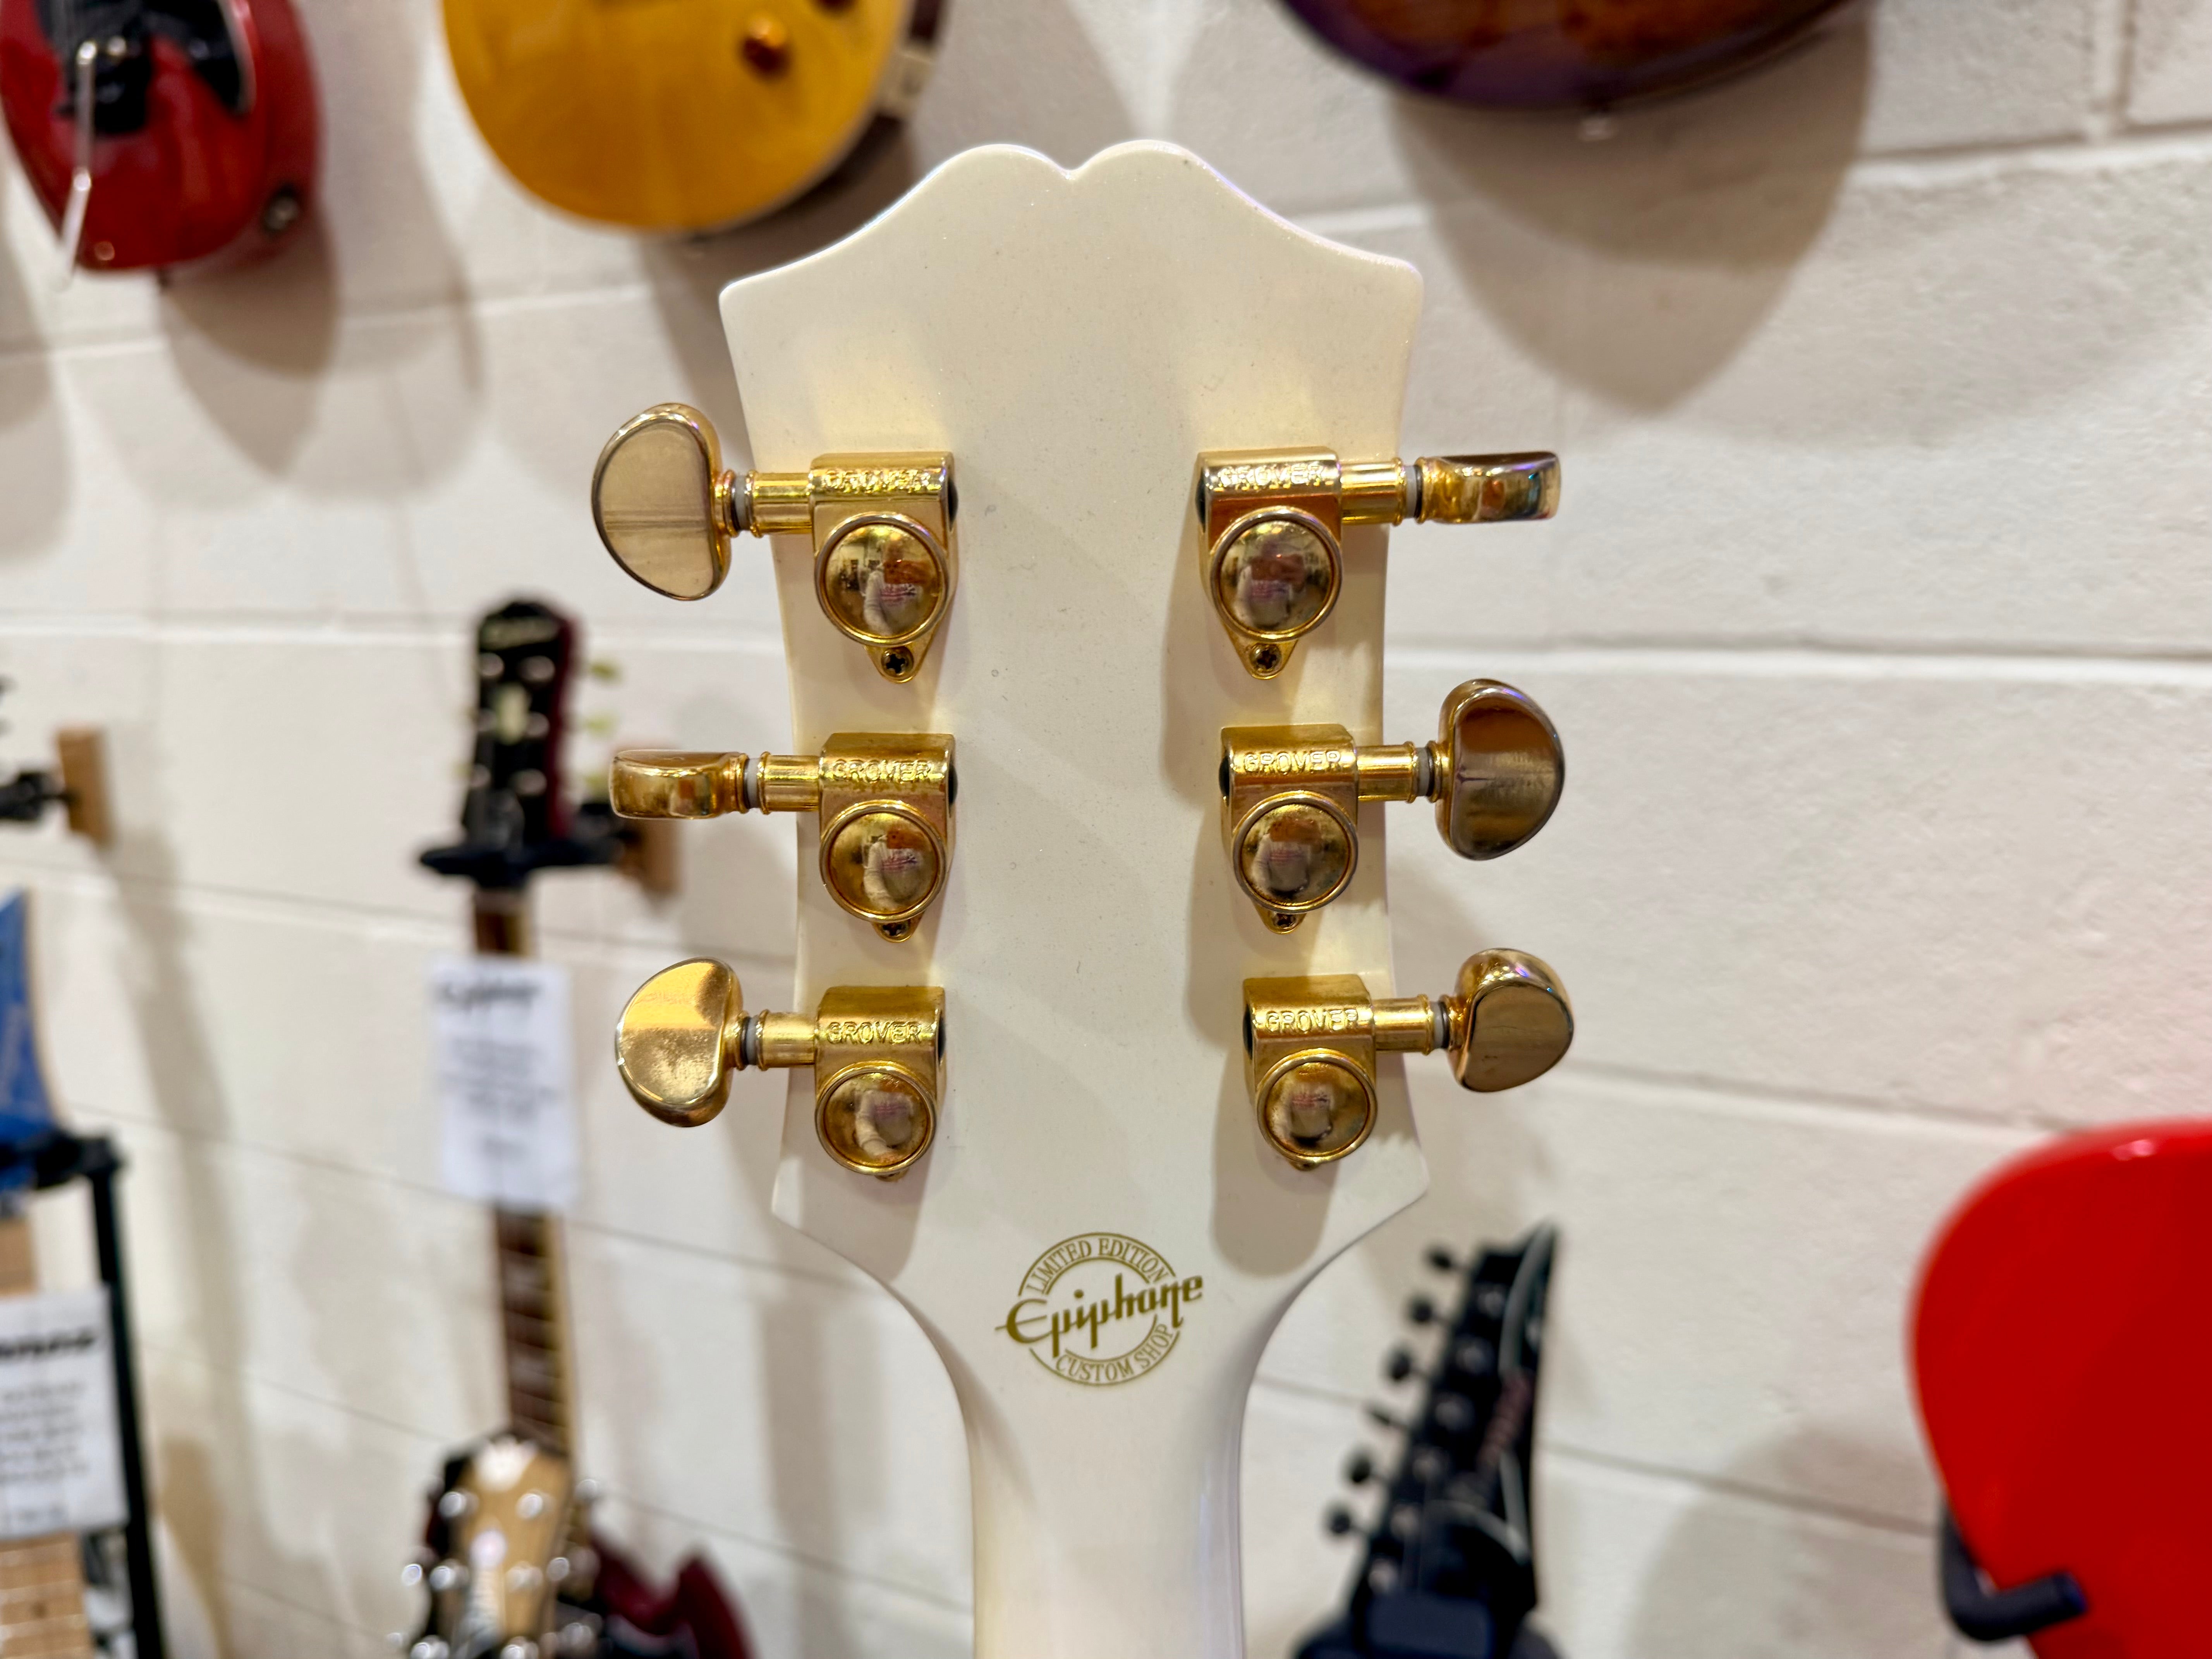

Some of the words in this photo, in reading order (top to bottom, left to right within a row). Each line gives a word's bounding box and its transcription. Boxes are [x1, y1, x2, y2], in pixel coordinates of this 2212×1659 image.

[1217, 463, 1324, 490] GROVER
[832, 760, 934, 784] GROVER
[1243, 750, 1341, 775] GROVER
[826, 1021, 922, 1045] GROVER
[1265, 1008, 1359, 1035] GROVER
[1026, 1240, 1092, 1294] LIMITED
[1098, 1238, 1169, 1283] EDITION
[994, 1273, 1203, 1358] Epiphone
[1056, 1355, 1135, 1382] CUSTOM
[1133, 1323, 1174, 1369] SHOP
